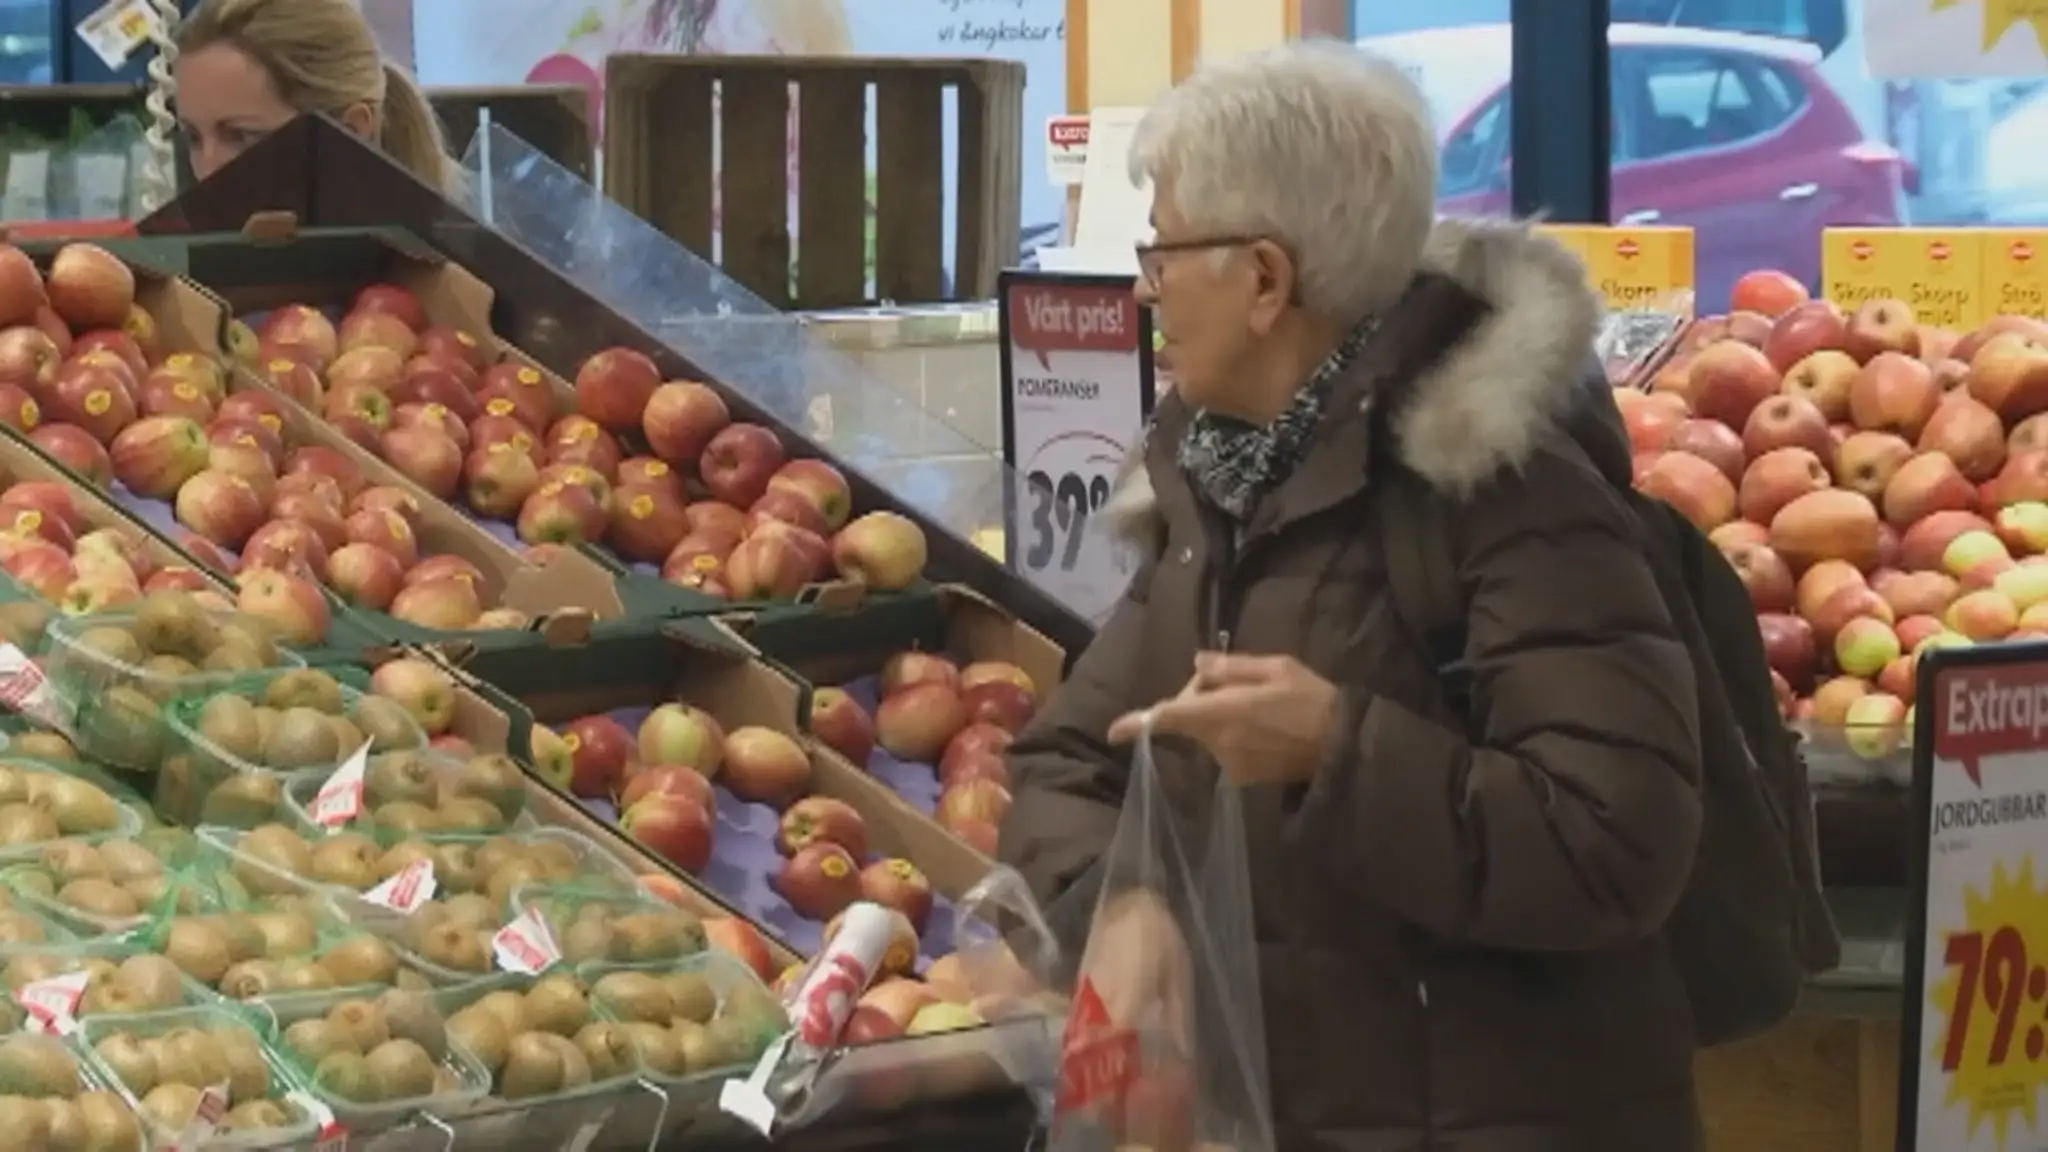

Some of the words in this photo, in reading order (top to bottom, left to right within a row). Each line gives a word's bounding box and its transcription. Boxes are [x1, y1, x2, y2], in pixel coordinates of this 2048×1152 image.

[1023, 290, 1073, 333] Vårt
[1077, 297, 1124, 342] pris!
[1018, 378, 1100, 400] POMERANSER
[1934, 793, 2047, 834] JORDGUBBAR
